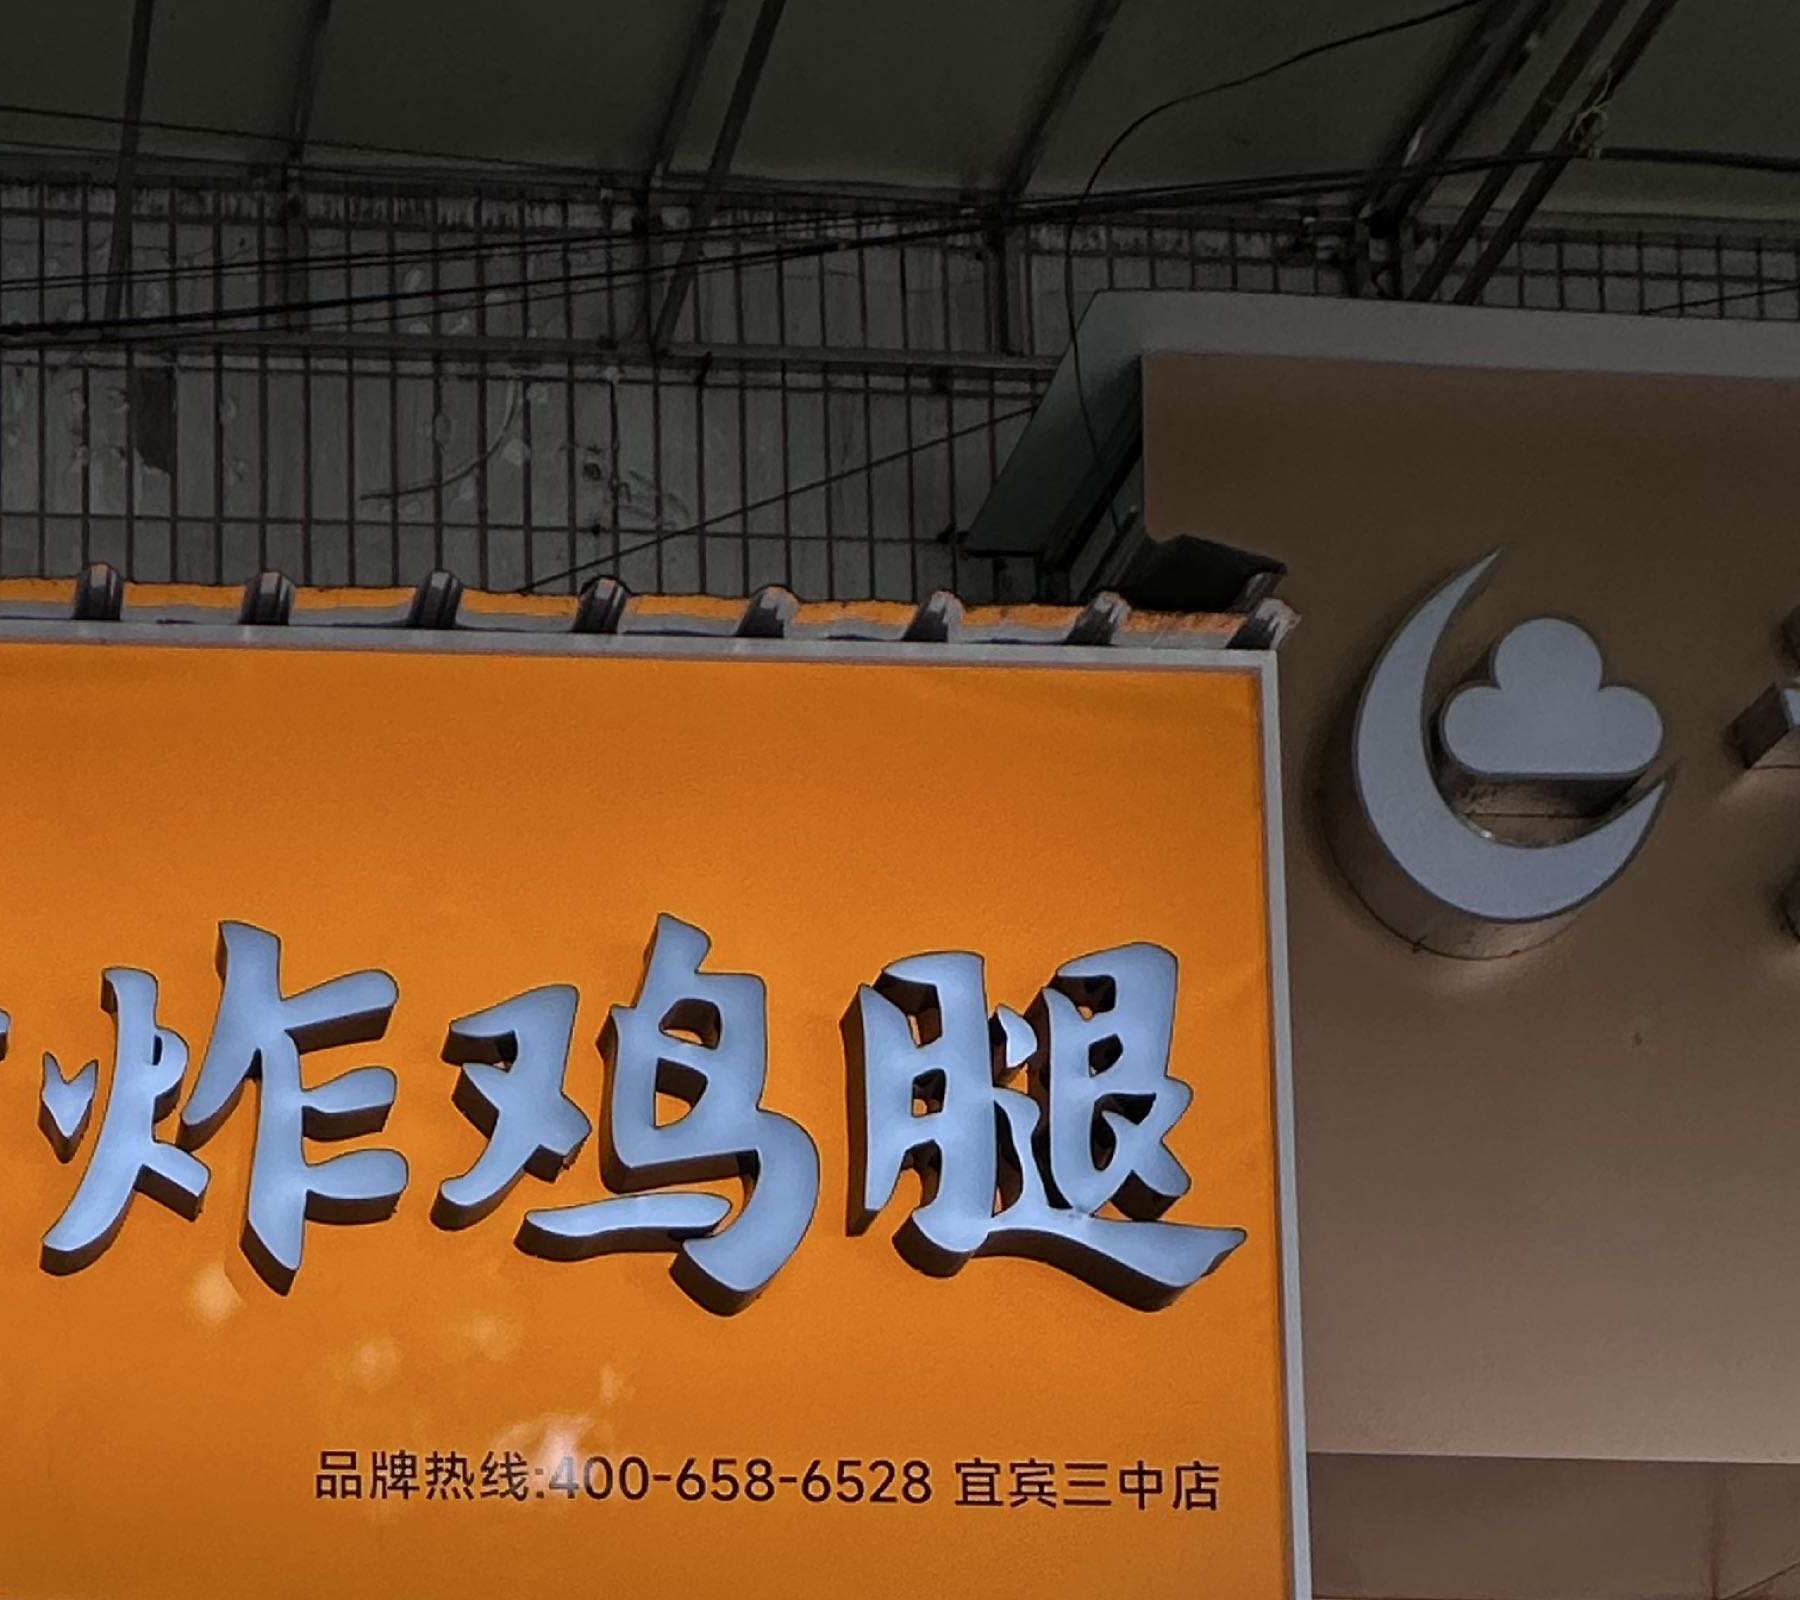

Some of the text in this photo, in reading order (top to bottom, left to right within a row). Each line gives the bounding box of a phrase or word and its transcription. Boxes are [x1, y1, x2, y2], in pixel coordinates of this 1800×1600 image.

[953, 1460, 1221, 1511] 宜宾三中店
